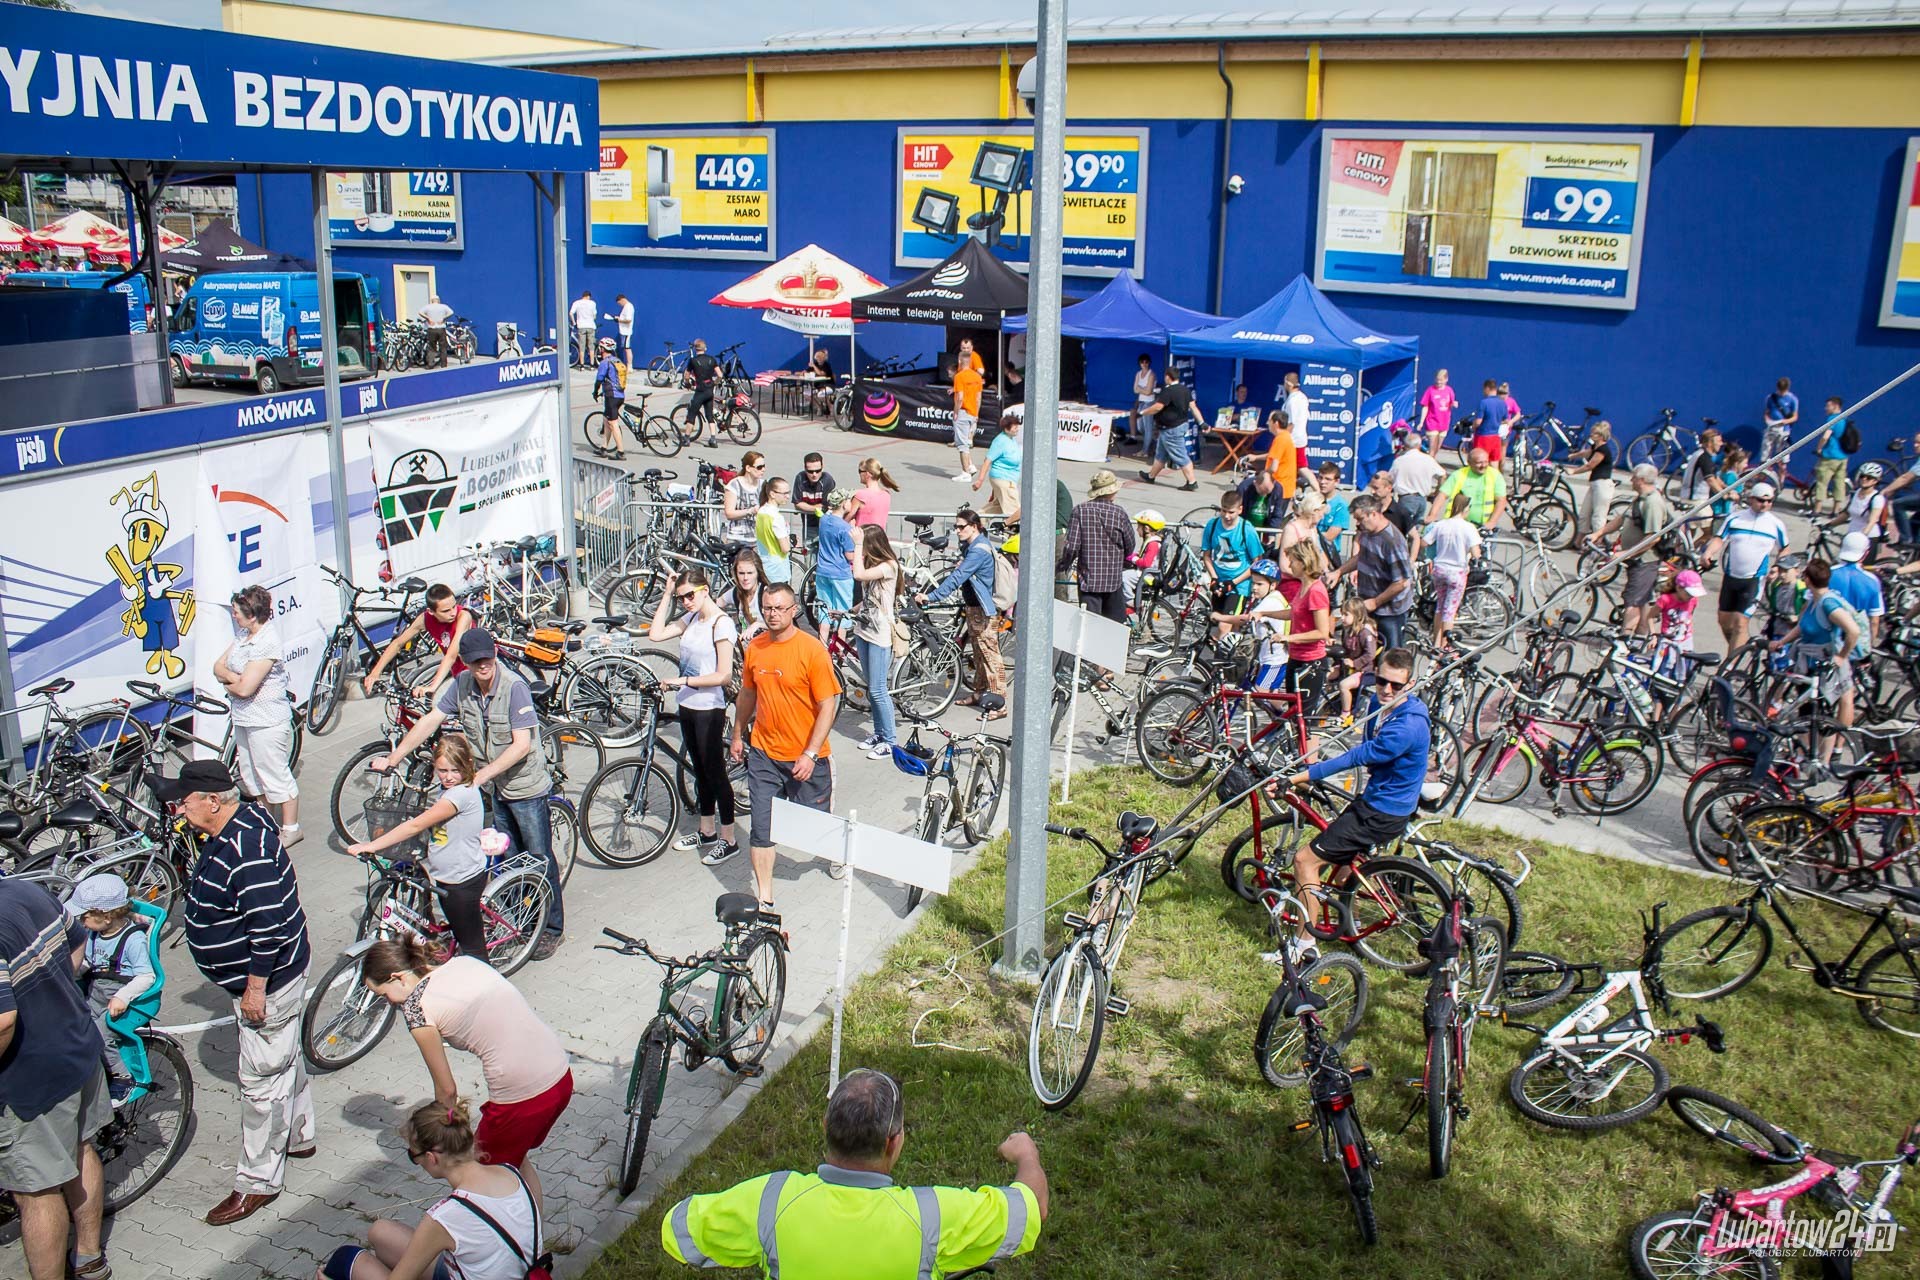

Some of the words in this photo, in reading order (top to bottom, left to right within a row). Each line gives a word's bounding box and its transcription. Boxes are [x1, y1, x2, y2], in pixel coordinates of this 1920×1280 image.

[0, 47, 208, 123] YJNIA
[233, 71, 583, 146] BEZDOTYKOWA
[914, 146, 939, 161] HIT
[1355, 151, 1385, 171] HIT!
[1344, 166, 1389, 188] cenowy
[726, 195, 761, 204] ZESTAW
[734, 209, 761, 217] MARO
[1107, 215, 1126, 224] LED
[1532, 208, 1549, 221] od
[402, 227, 452, 236] www.mrowka.com.pl
[694, 233, 763, 242] www.mrowka.com.pl
[1558, 235, 1619, 247] SKRZYDŁO
[1063, 245, 1127, 257] mrowka.com.pl
[1510, 246, 1574, 259] DRZWIOWE
[1577, 251, 1617, 262] HELIOS
[203, 282, 237, 291] Autoryzowany
[263, 281, 280, 289] MAPEI
[1500, 272, 1616, 291] www.mrowka.com.pl
[906, 288, 964, 300] interduo
[867, 305, 900, 317] internet
[906, 308, 944, 320] telewizja
[951, 310, 983, 322] telefon
[1231, 330, 1290, 342] Allianz
[499, 359, 551, 383] MRÓWKA
[1303, 374, 1339, 386] Allianz
[360, 384, 378, 414] psb
[237, 398, 316, 428] MRÓWKA
[905, 420, 930, 428] operator
[16, 434, 47, 471] psb
[461, 446, 509, 473] LUBELSKI
[501, 482, 538, 500] AKCYJNA
[278, 595, 302, 616] S.A.
